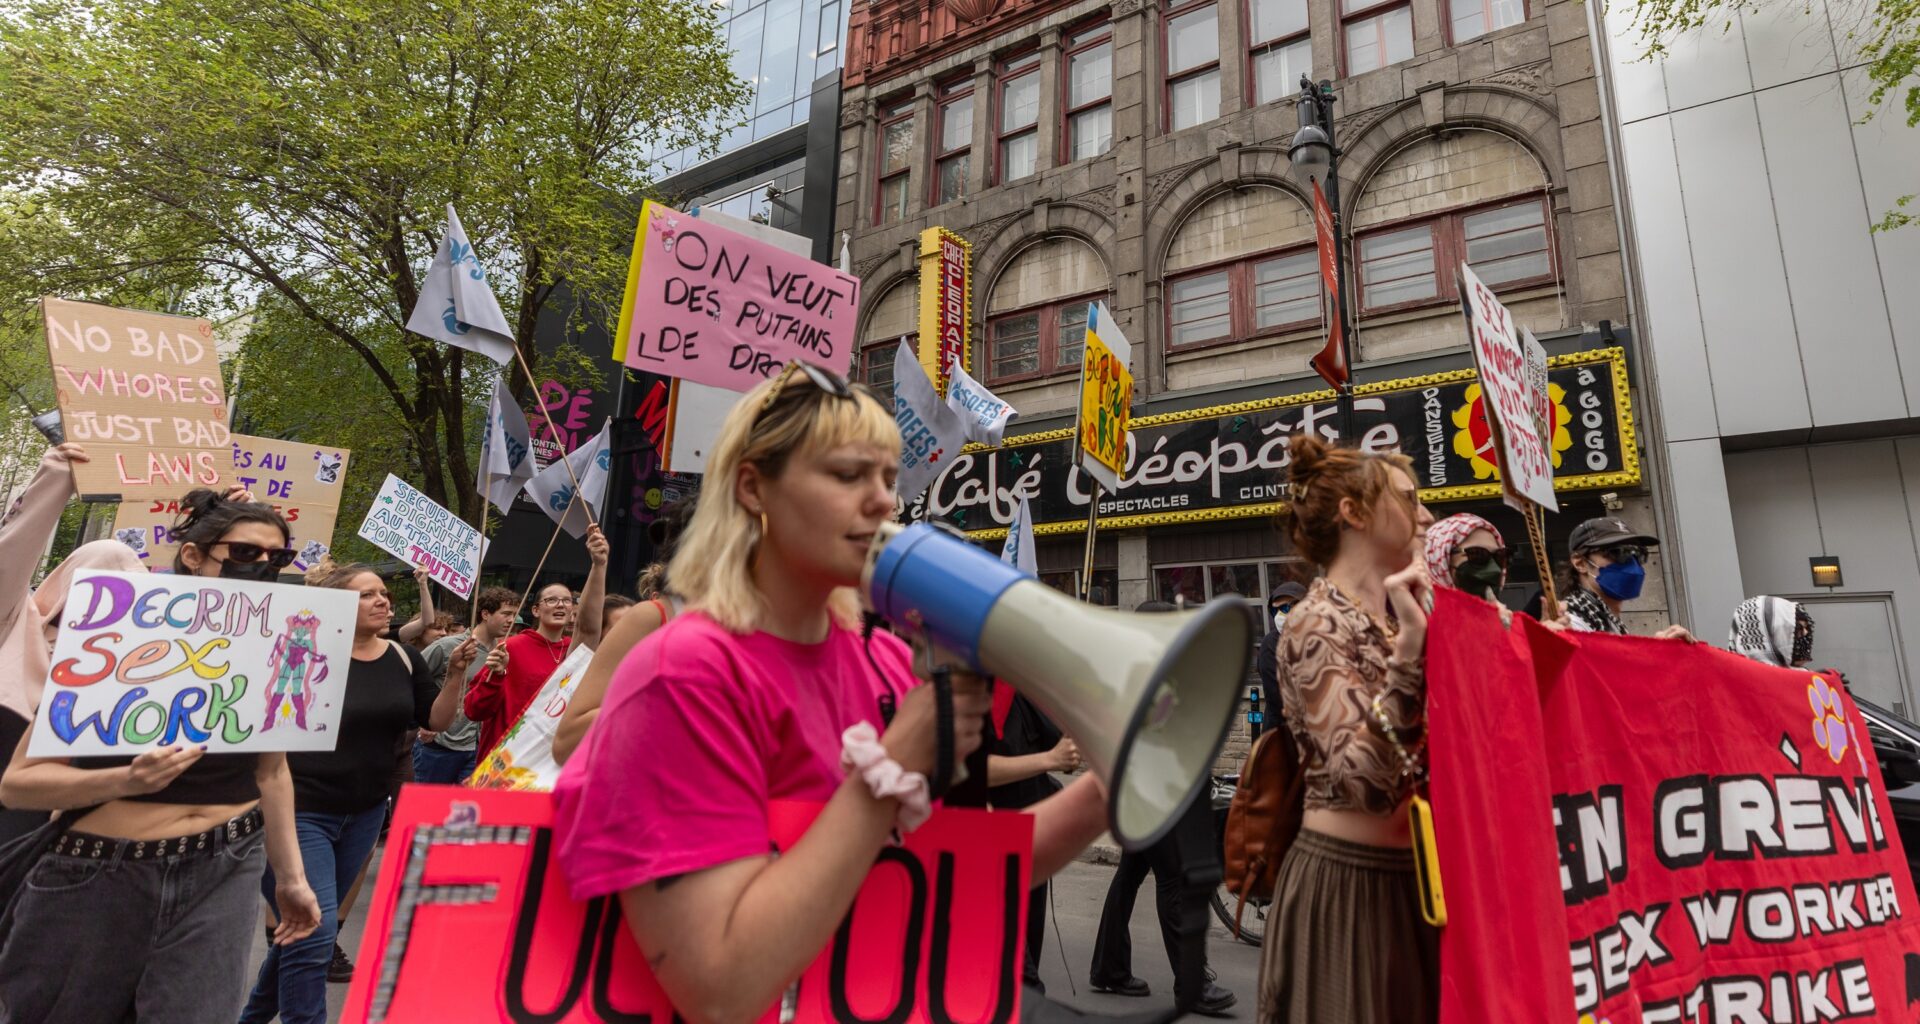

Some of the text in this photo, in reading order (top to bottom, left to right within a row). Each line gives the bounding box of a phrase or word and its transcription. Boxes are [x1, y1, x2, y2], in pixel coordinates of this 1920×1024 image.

[675, 231, 843, 316] ON VEUT
[46, 316, 204, 365] NO BAD
[659, 327, 699, 360] DE
[664, 277, 833, 358] DES PUTAINS
[60, 364, 223, 407] WHORES
[70, 409, 231, 449] JUST BAD
[1423, 388, 1446, 486] DANSEUSES
[1579, 391, 1609, 471] GOGO
[115, 451, 220, 487] LAWS
[259, 453, 287, 471] AU
[267, 479, 293, 498] DE
[930, 452, 1042, 524] Café
[1099, 495, 1190, 514] SPECTACLES
[362, 518, 473, 597] POUR TOUTES!
[374, 508, 471, 578] AU TRAVAIL
[68, 575, 273, 638] DECRIM
[1568, 874, 1901, 1014] SEX WORKER
